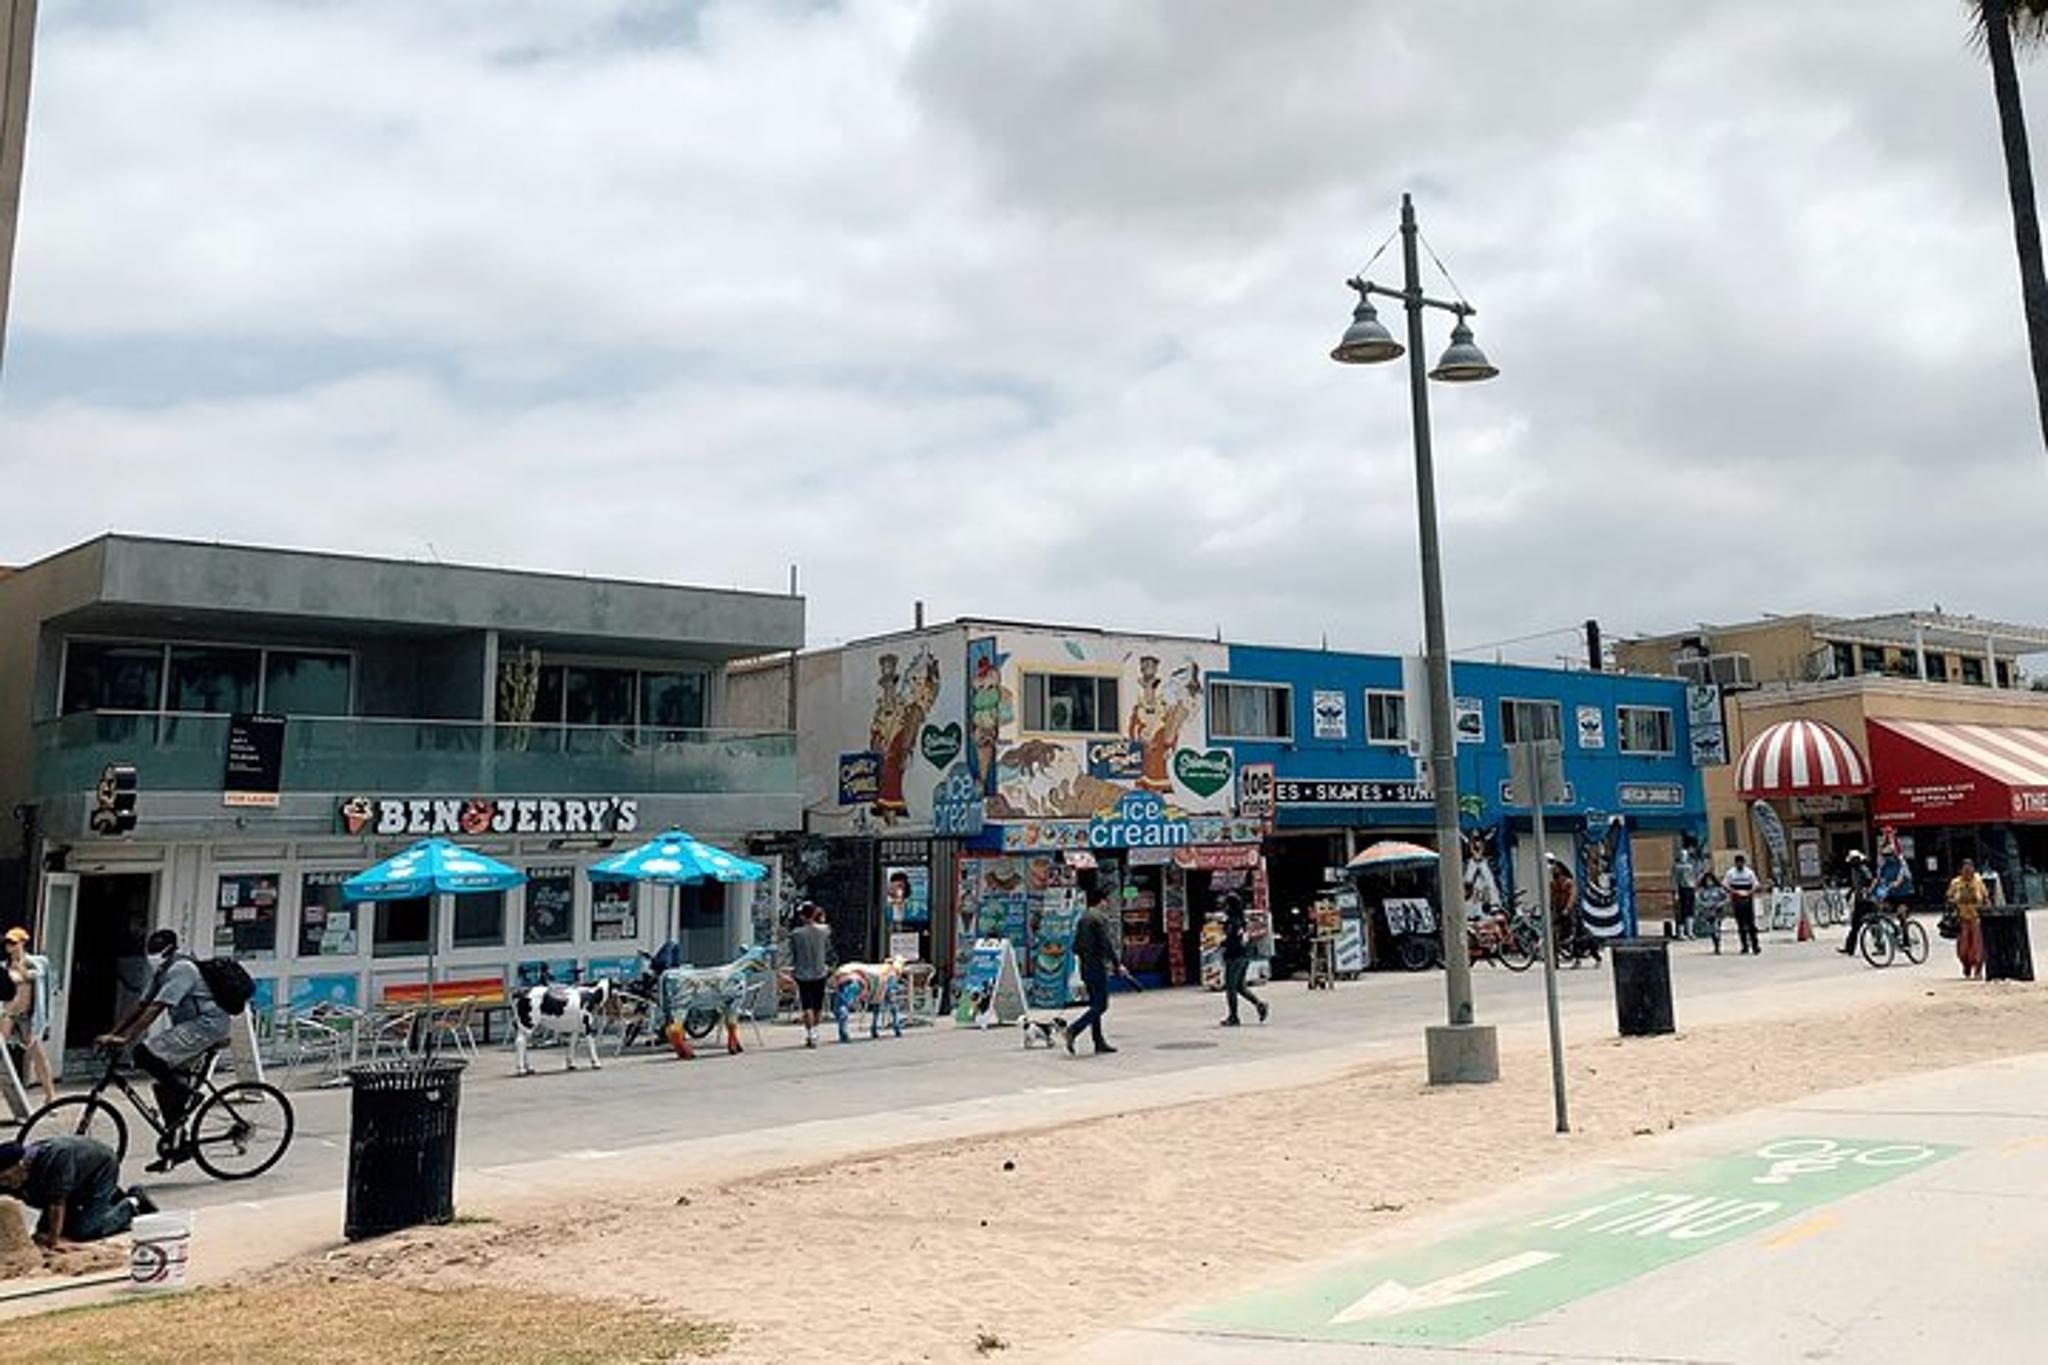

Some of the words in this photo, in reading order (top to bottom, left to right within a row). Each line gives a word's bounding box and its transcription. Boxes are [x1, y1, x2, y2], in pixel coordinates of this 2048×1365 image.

[1276, 784, 1300, 800] ES
[1316, 784, 1382, 800] SKATES
[377, 801, 460, 833] BEN
[492, 796, 638, 833] JERRY'S
[1123, 801, 1160, 820] ice
[1090, 823, 1190, 847] cream
